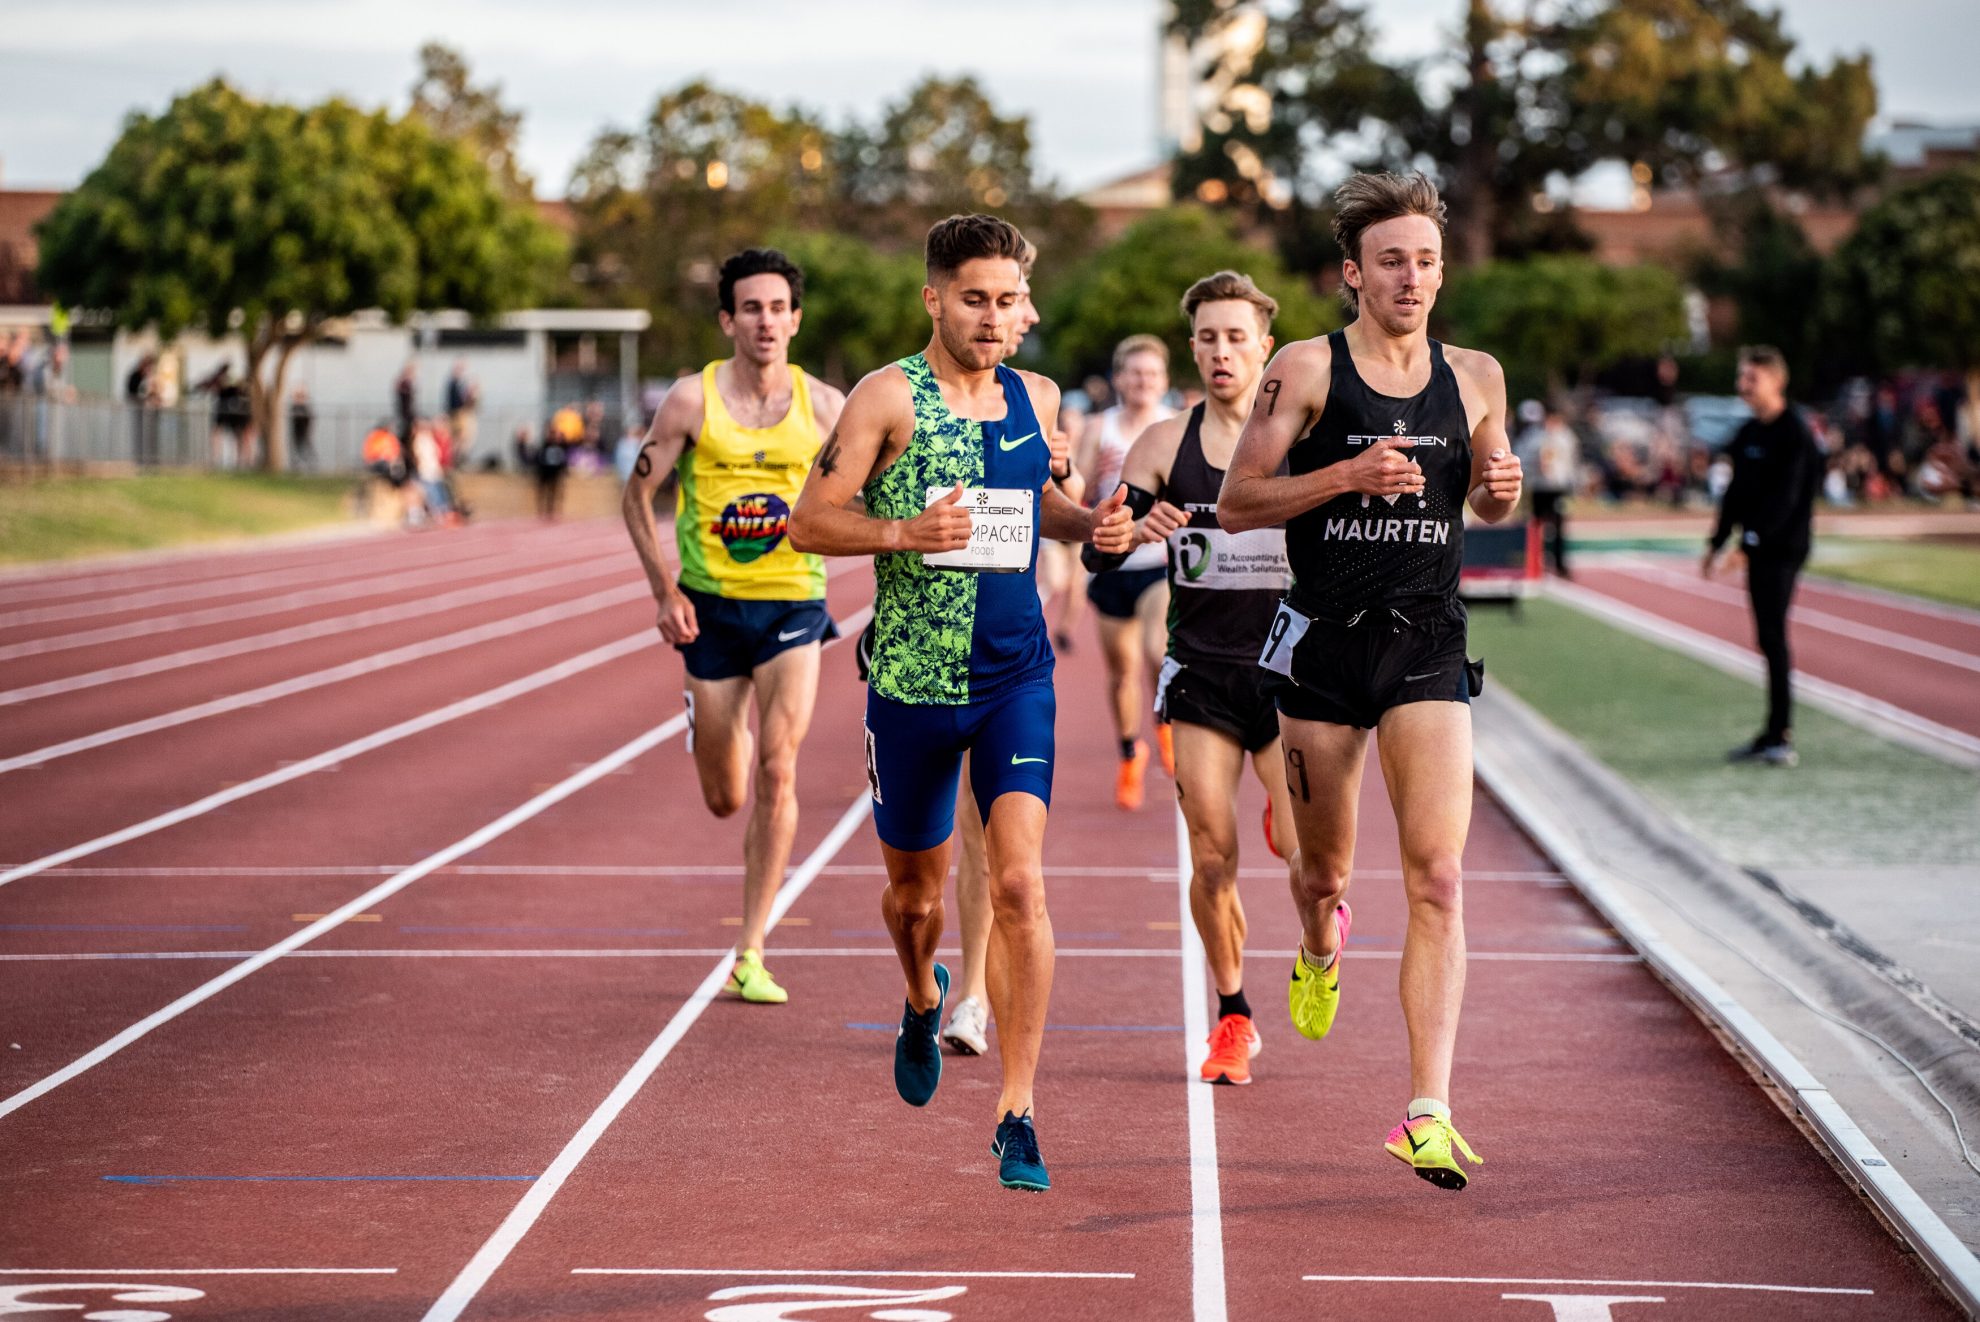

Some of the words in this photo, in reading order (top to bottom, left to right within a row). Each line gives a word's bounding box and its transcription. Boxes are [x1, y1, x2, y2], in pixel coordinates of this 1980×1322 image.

[1346, 434, 1447, 447] STGEN
[635, 441, 657, 478] 6
[965, 506, 1024, 515] EIGEN
[967, 525, 1031, 543] MPACKET
[1324, 518, 1450, 545] MAURTEN
[970, 546, 995, 556] FOODS
[1230, 553, 1279, 564] Accounting
[1217, 564, 1248, 574] Wealth
[1250, 564, 1289, 574] Solutions
